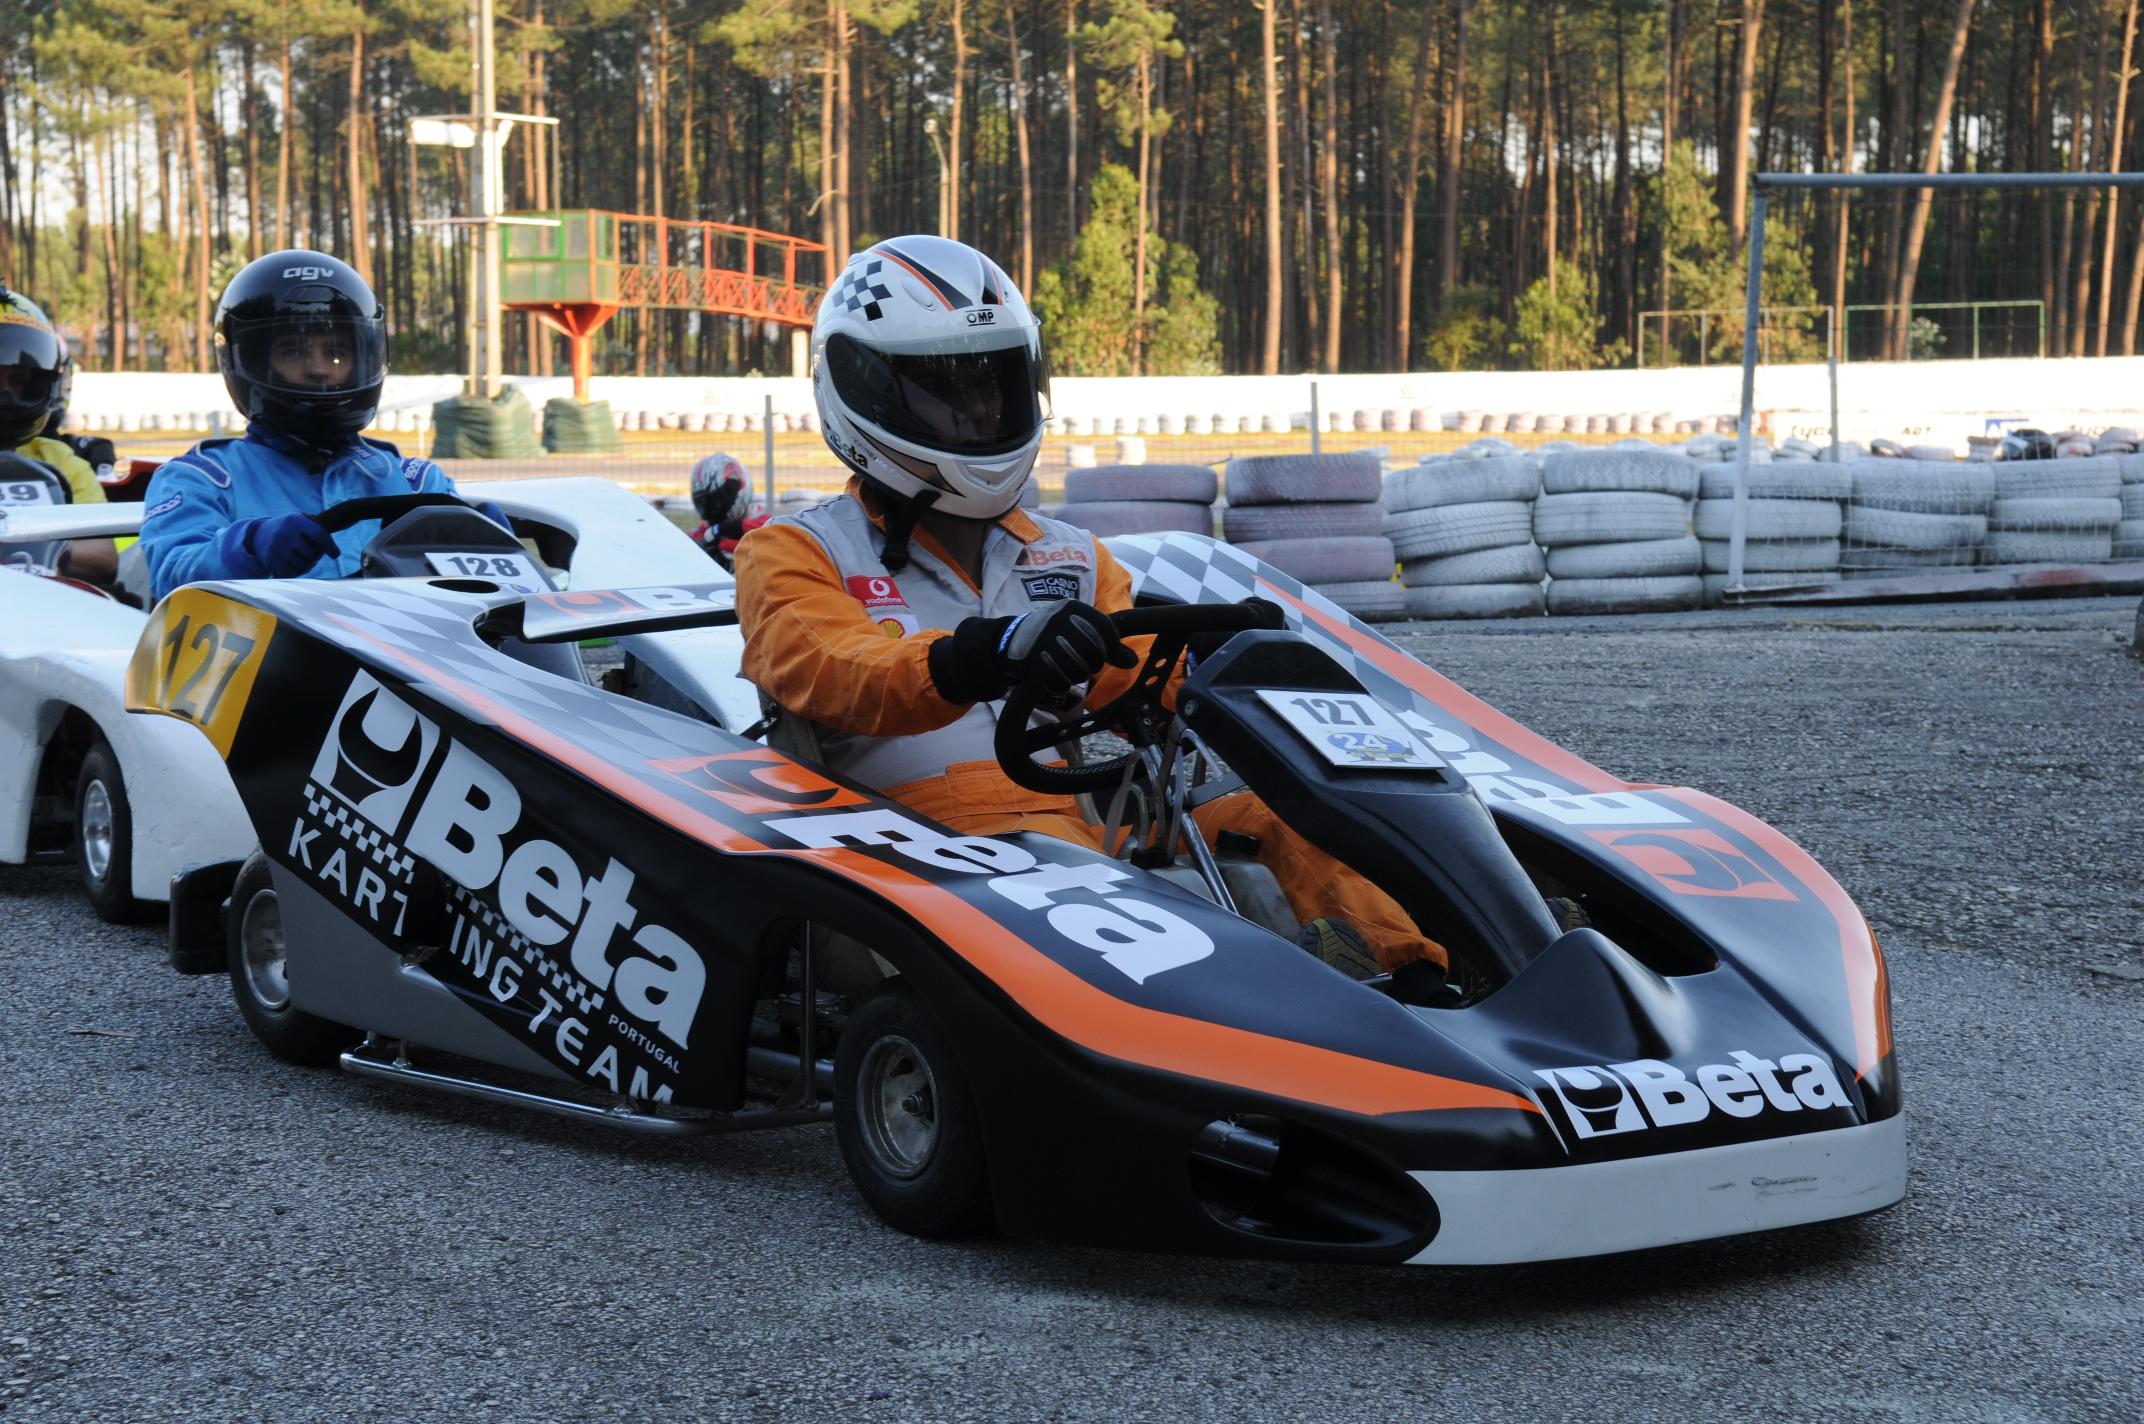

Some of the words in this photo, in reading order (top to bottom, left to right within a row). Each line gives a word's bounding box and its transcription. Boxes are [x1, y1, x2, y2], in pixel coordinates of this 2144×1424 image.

[283, 266, 334, 280] agv
[966, 311, 994, 323] OMP
[0, 484, 40, 501] 9
[446, 556, 521, 577] 128
[1031, 545, 1089, 566] Beta
[158, 614, 256, 726] 127
[1290, 697, 1376, 727] 127
[1333, 732, 1389, 751] 24
[403, 736, 707, 1050] Beta
[527, 986, 674, 1104] TEAM
[607, 1013, 681, 1074] PORTUGAL
[1604, 1050, 1854, 1128] Beta
